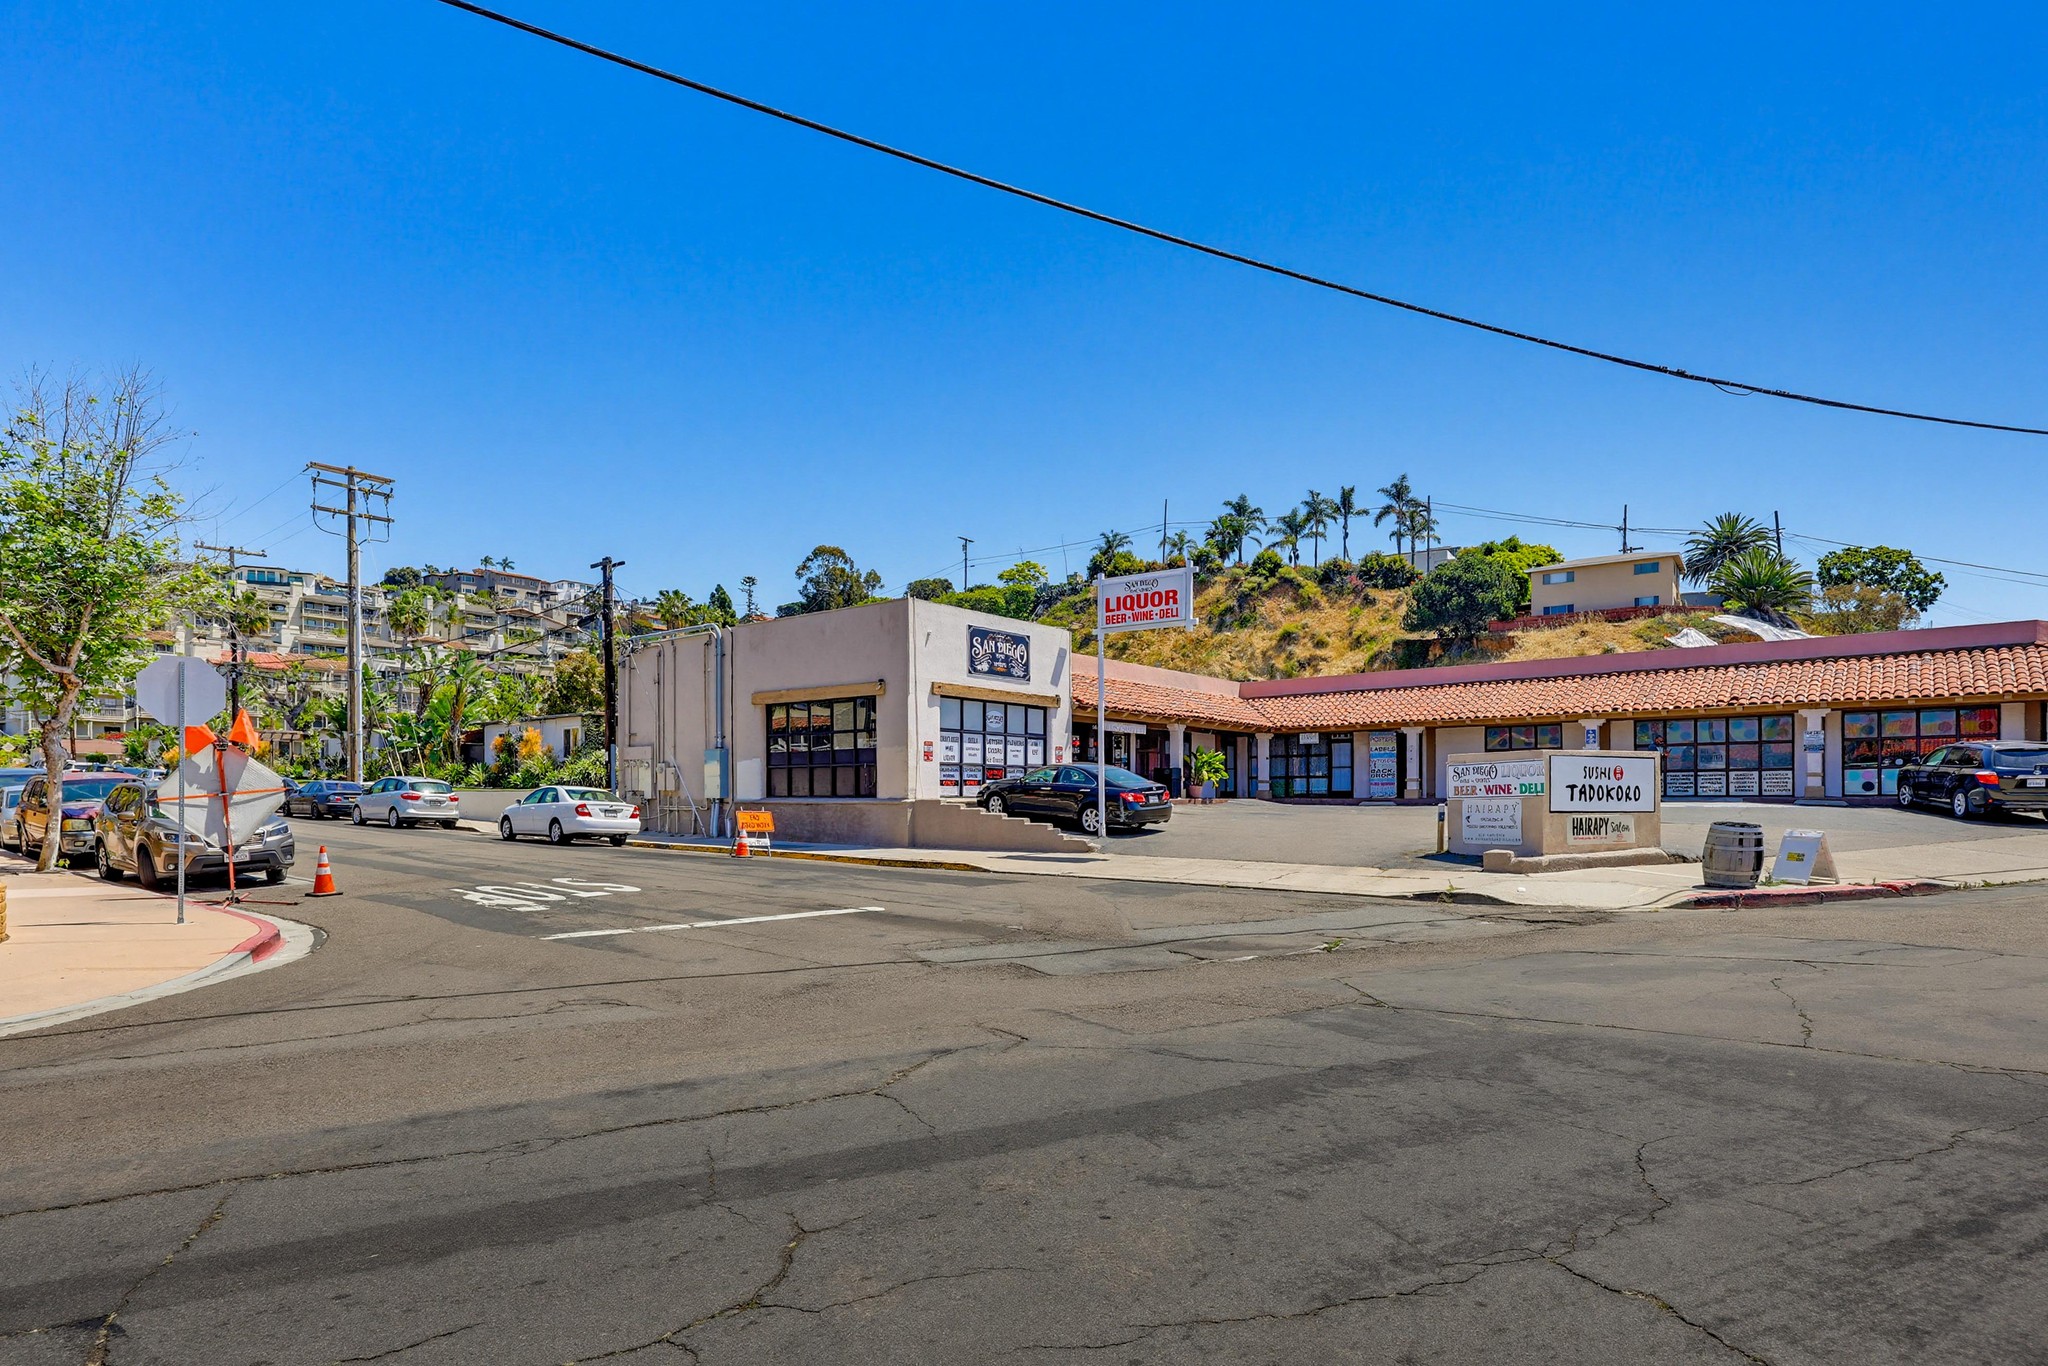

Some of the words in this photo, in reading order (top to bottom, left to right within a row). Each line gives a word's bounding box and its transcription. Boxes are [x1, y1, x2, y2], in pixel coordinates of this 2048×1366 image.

[1105, 589, 1179, 613] LIQUOR
[1105, 613, 1127, 625] BEER
[1131, 610, 1154, 622] WINE
[1159, 607, 1179, 619] DELI
[972, 636, 996, 658] SAN
[997, 641, 1027, 664] DIEGO
[1452, 766, 1470, 782] SAN
[1472, 764, 1497, 780] DIEGO
[1583, 766, 1611, 780] SUSHI
[1453, 785, 1478, 796] BEER
[1519, 782, 1545, 795] DELI
[1565, 783, 1641, 802] TADOKORO
[1467, 803, 1518, 814] HAIRAPY
[1572, 817, 1609, 836] HAIRAPY
[1610, 821, 1630, 834] Salon
